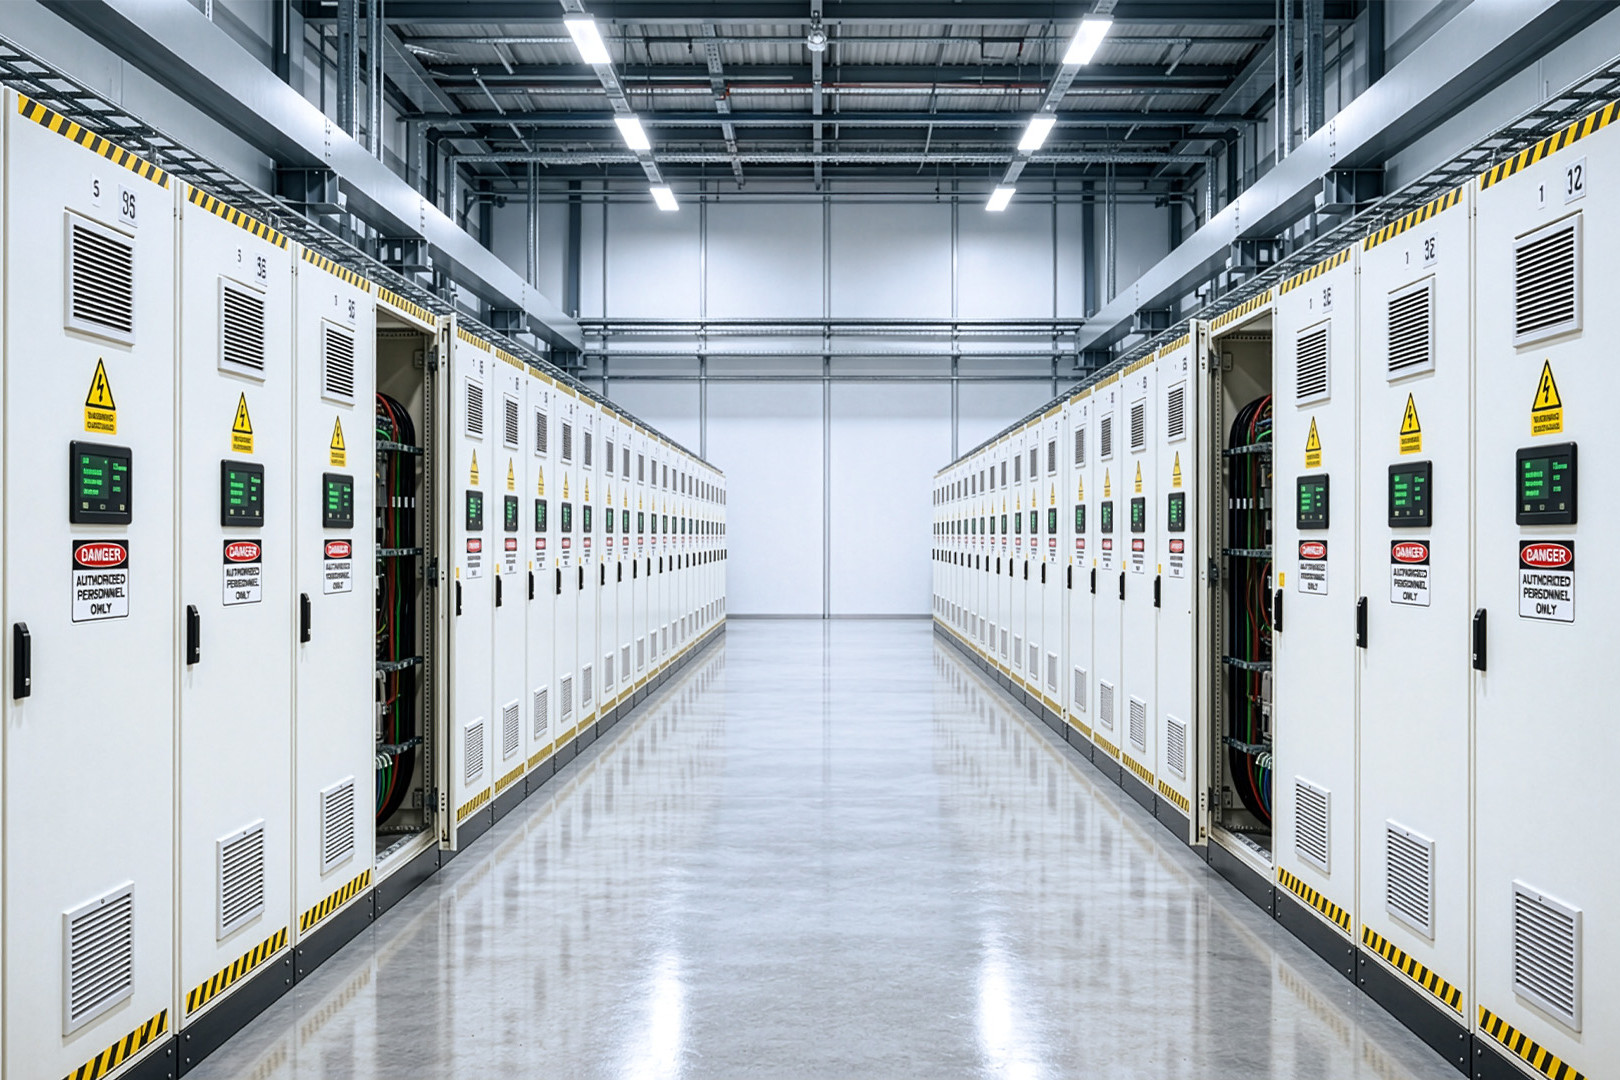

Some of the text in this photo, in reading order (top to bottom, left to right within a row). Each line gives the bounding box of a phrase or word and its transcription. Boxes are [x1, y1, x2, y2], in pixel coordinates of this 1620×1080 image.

[1539, 184, 1544, 203] 1
[81, 547, 121, 562] DANGER
[1526, 548, 1566, 562] DANGER
[1535, 602, 1557, 615] ONLY
